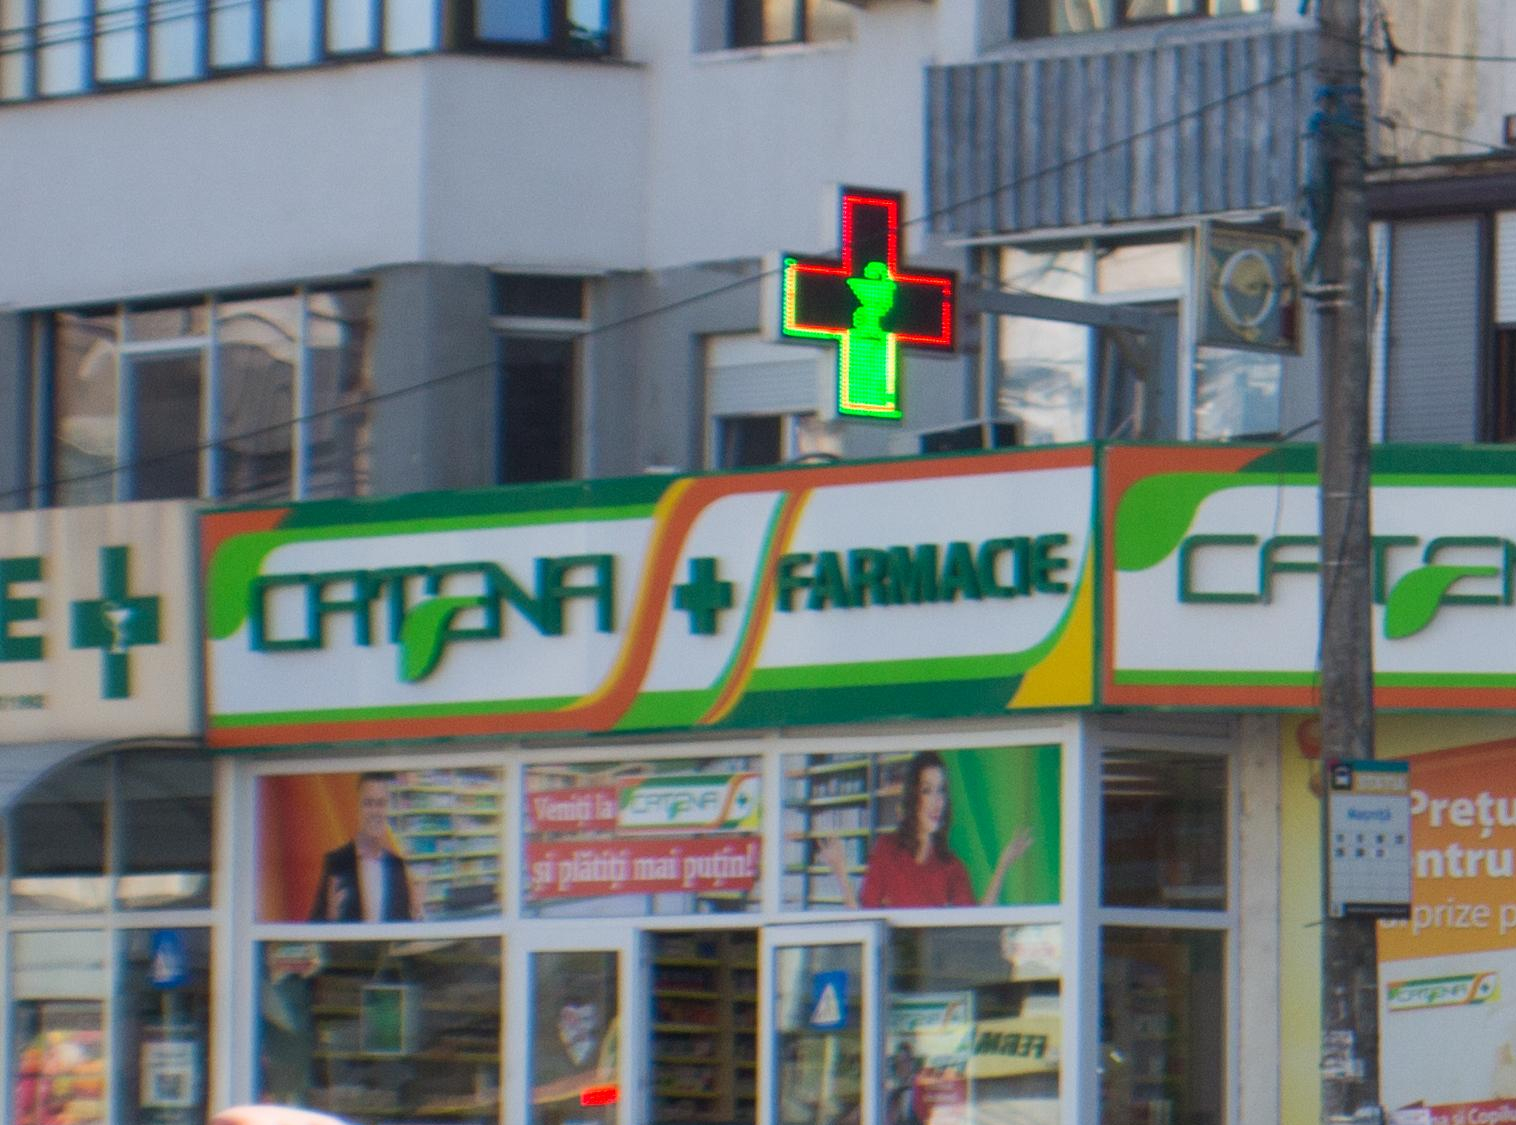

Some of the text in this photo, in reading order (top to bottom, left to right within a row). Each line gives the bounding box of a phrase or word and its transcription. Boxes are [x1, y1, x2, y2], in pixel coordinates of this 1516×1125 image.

[777, 532, 1068, 612] FARMACIE
[249, 554, 613, 683] CATENA
[634, 847, 682, 880] mai
[1416, 842, 1514, 878] ntru
[1379, 899, 1491, 935] prize
